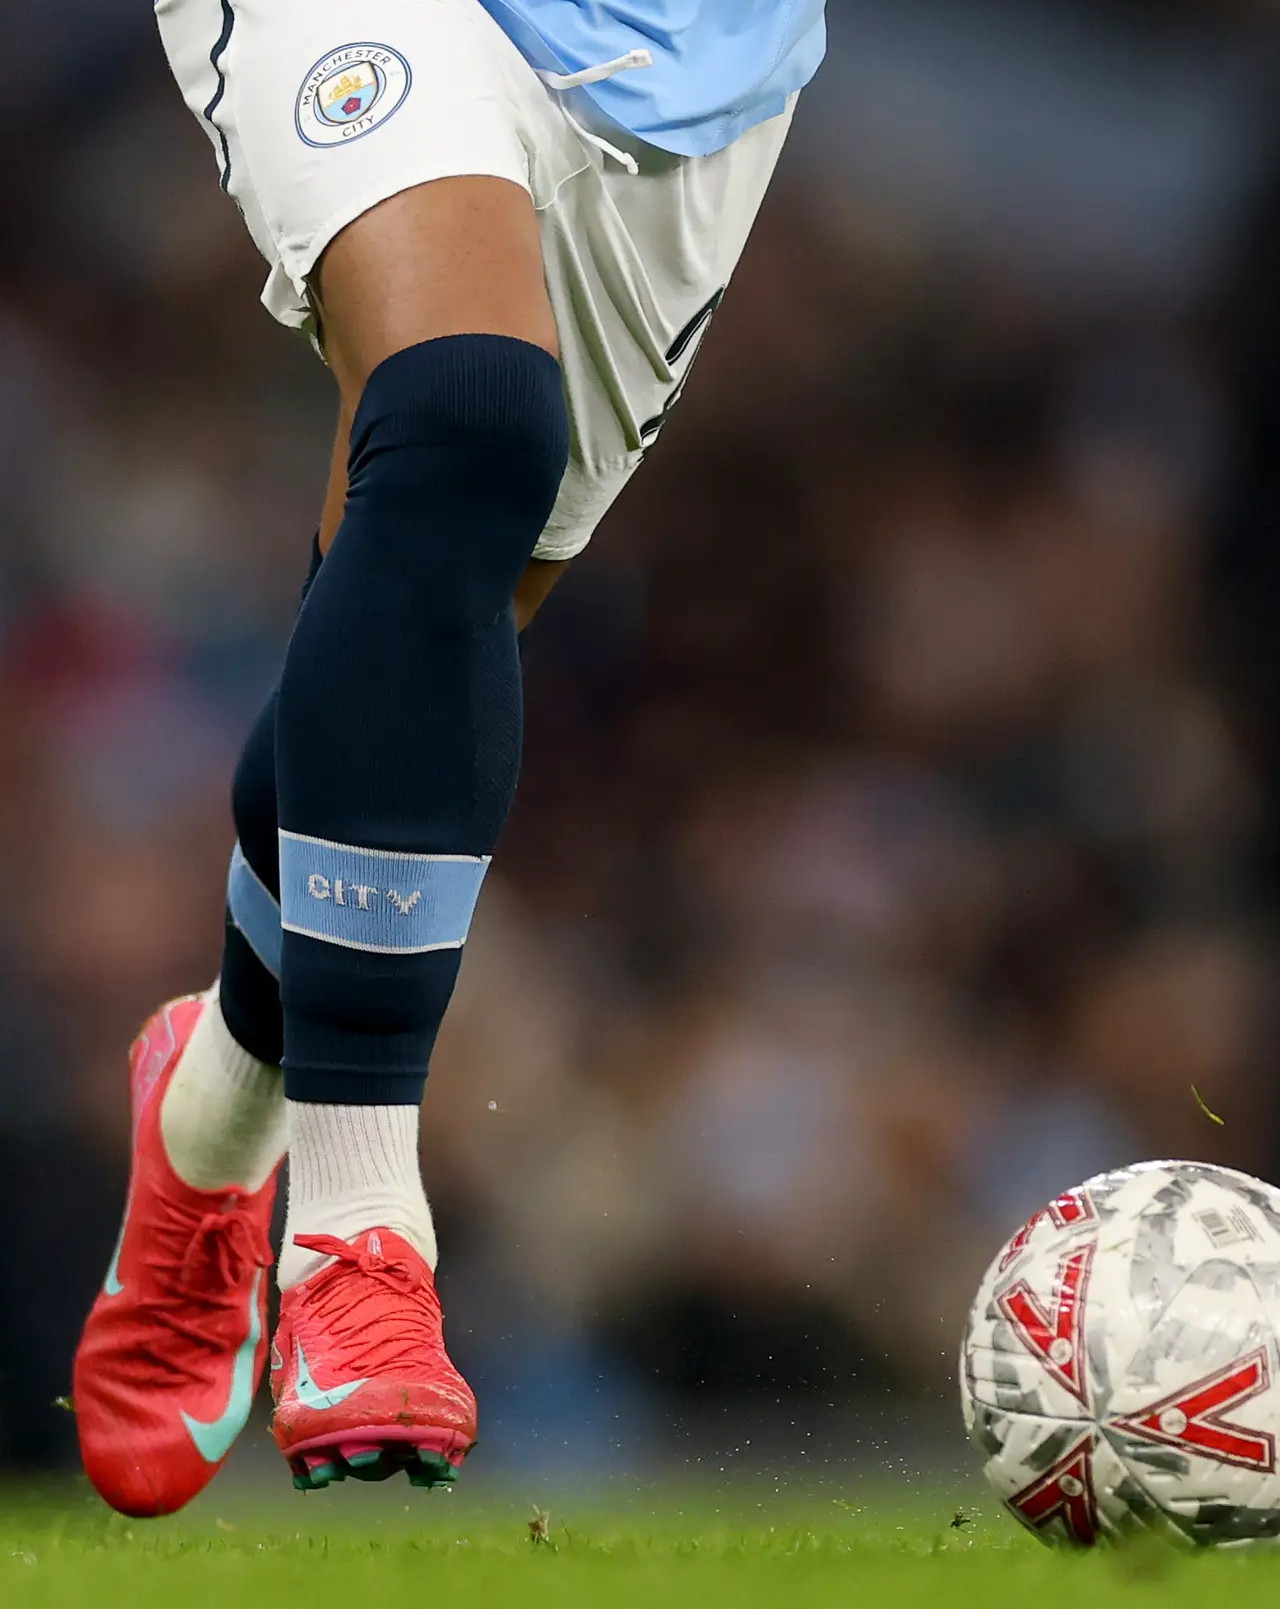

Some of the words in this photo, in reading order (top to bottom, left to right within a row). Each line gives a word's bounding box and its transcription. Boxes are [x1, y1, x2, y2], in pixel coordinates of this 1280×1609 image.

[303, 50, 392, 106] MANCHESTER
[342, 115, 374, 137] CITY
[307, 873, 421, 916] CITY
